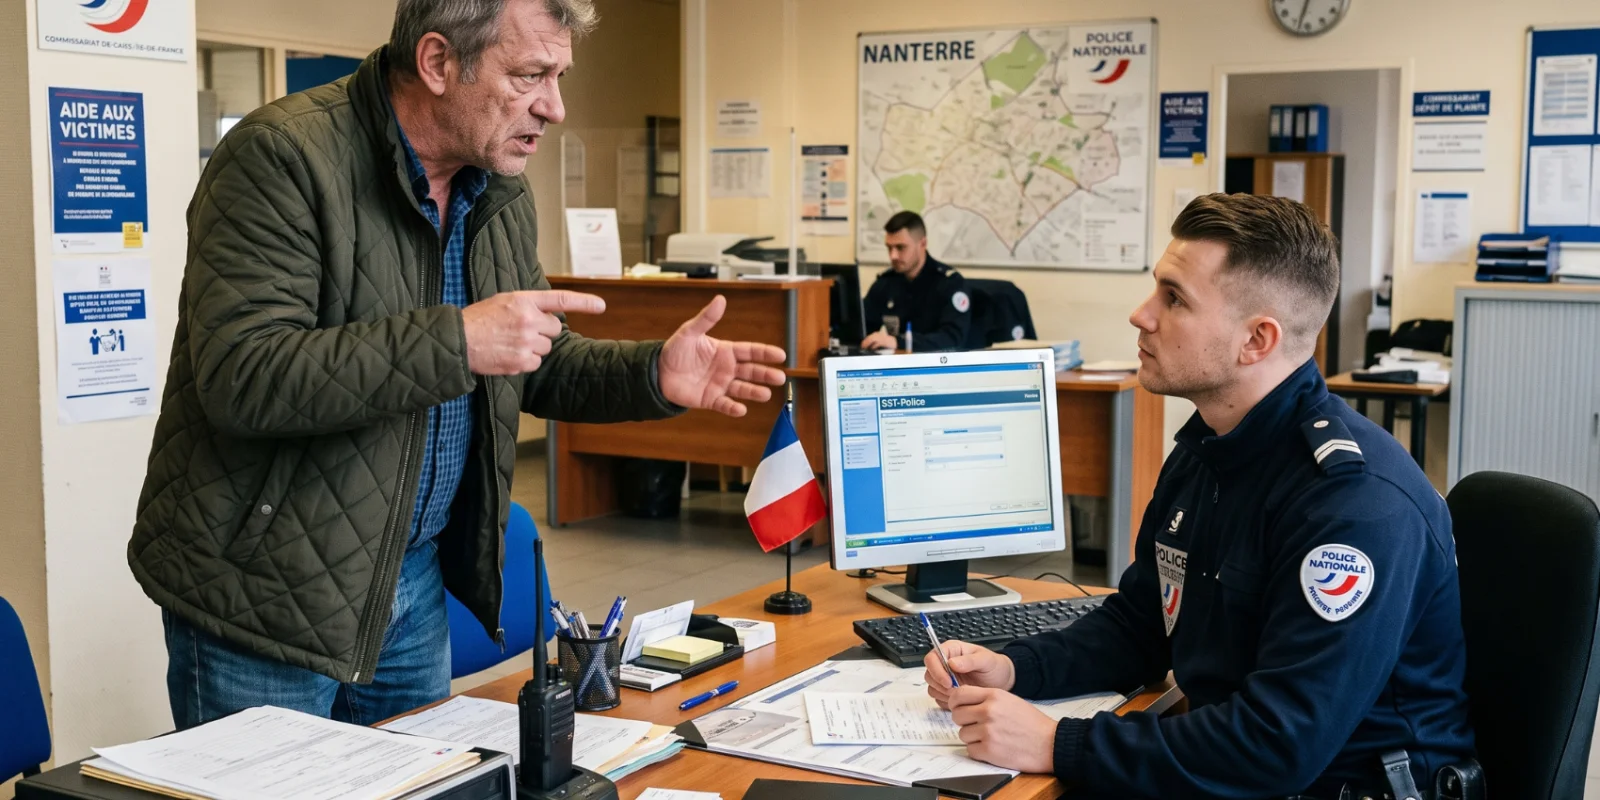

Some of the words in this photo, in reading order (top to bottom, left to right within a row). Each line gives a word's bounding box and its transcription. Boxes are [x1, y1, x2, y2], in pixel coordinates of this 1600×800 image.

[45, 35, 100, 47] COMMISSARIAT
[1086, 31, 1132, 43] POLICE
[863, 40, 975, 64] NANTERRE
[1073, 44, 1147, 57] NATIONALE
[60, 101, 99, 120] AIDE
[102, 104, 135, 121] AUX
[60, 121, 136, 141] VICTIMES
[881, 398, 926, 408] SST-Police
[1156, 545, 1187, 570] POLICE
[1321, 551, 1356, 563] POLICE
[1309, 560, 1366, 574] NATIONALE
